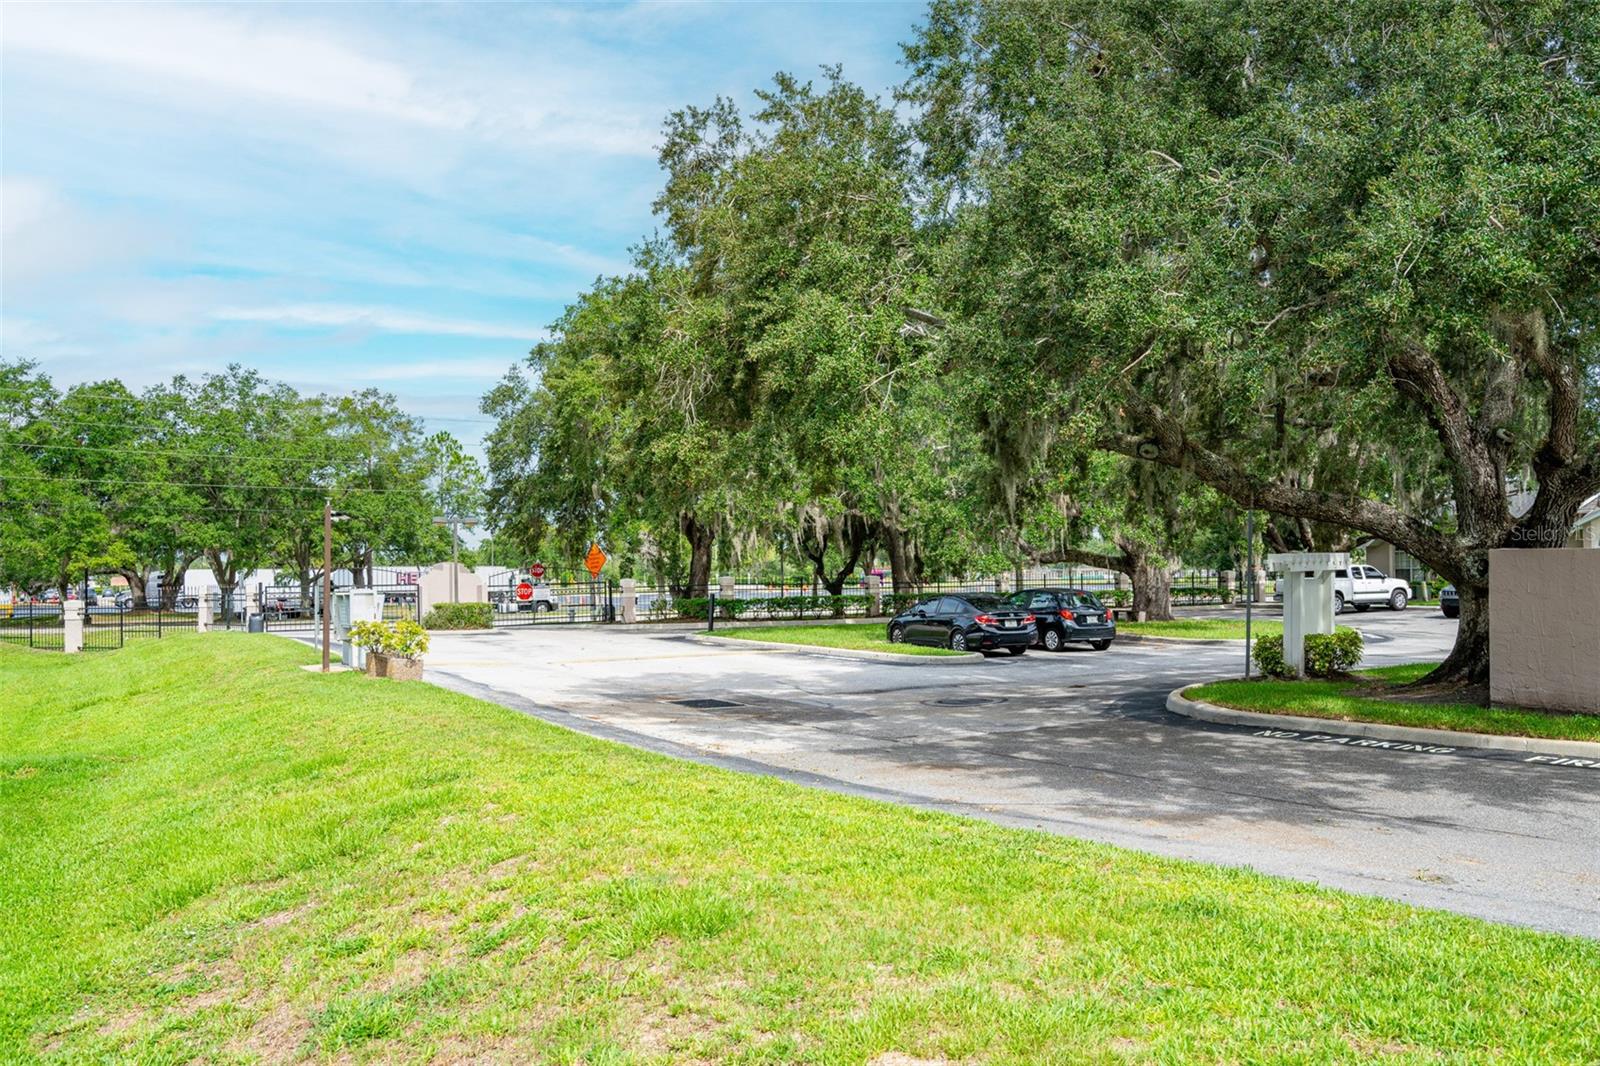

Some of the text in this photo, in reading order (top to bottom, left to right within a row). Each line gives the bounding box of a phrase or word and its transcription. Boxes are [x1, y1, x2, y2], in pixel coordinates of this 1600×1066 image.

[517, 587, 533, 596] STOP
[1253, 730, 1456, 754] NO PARKING
